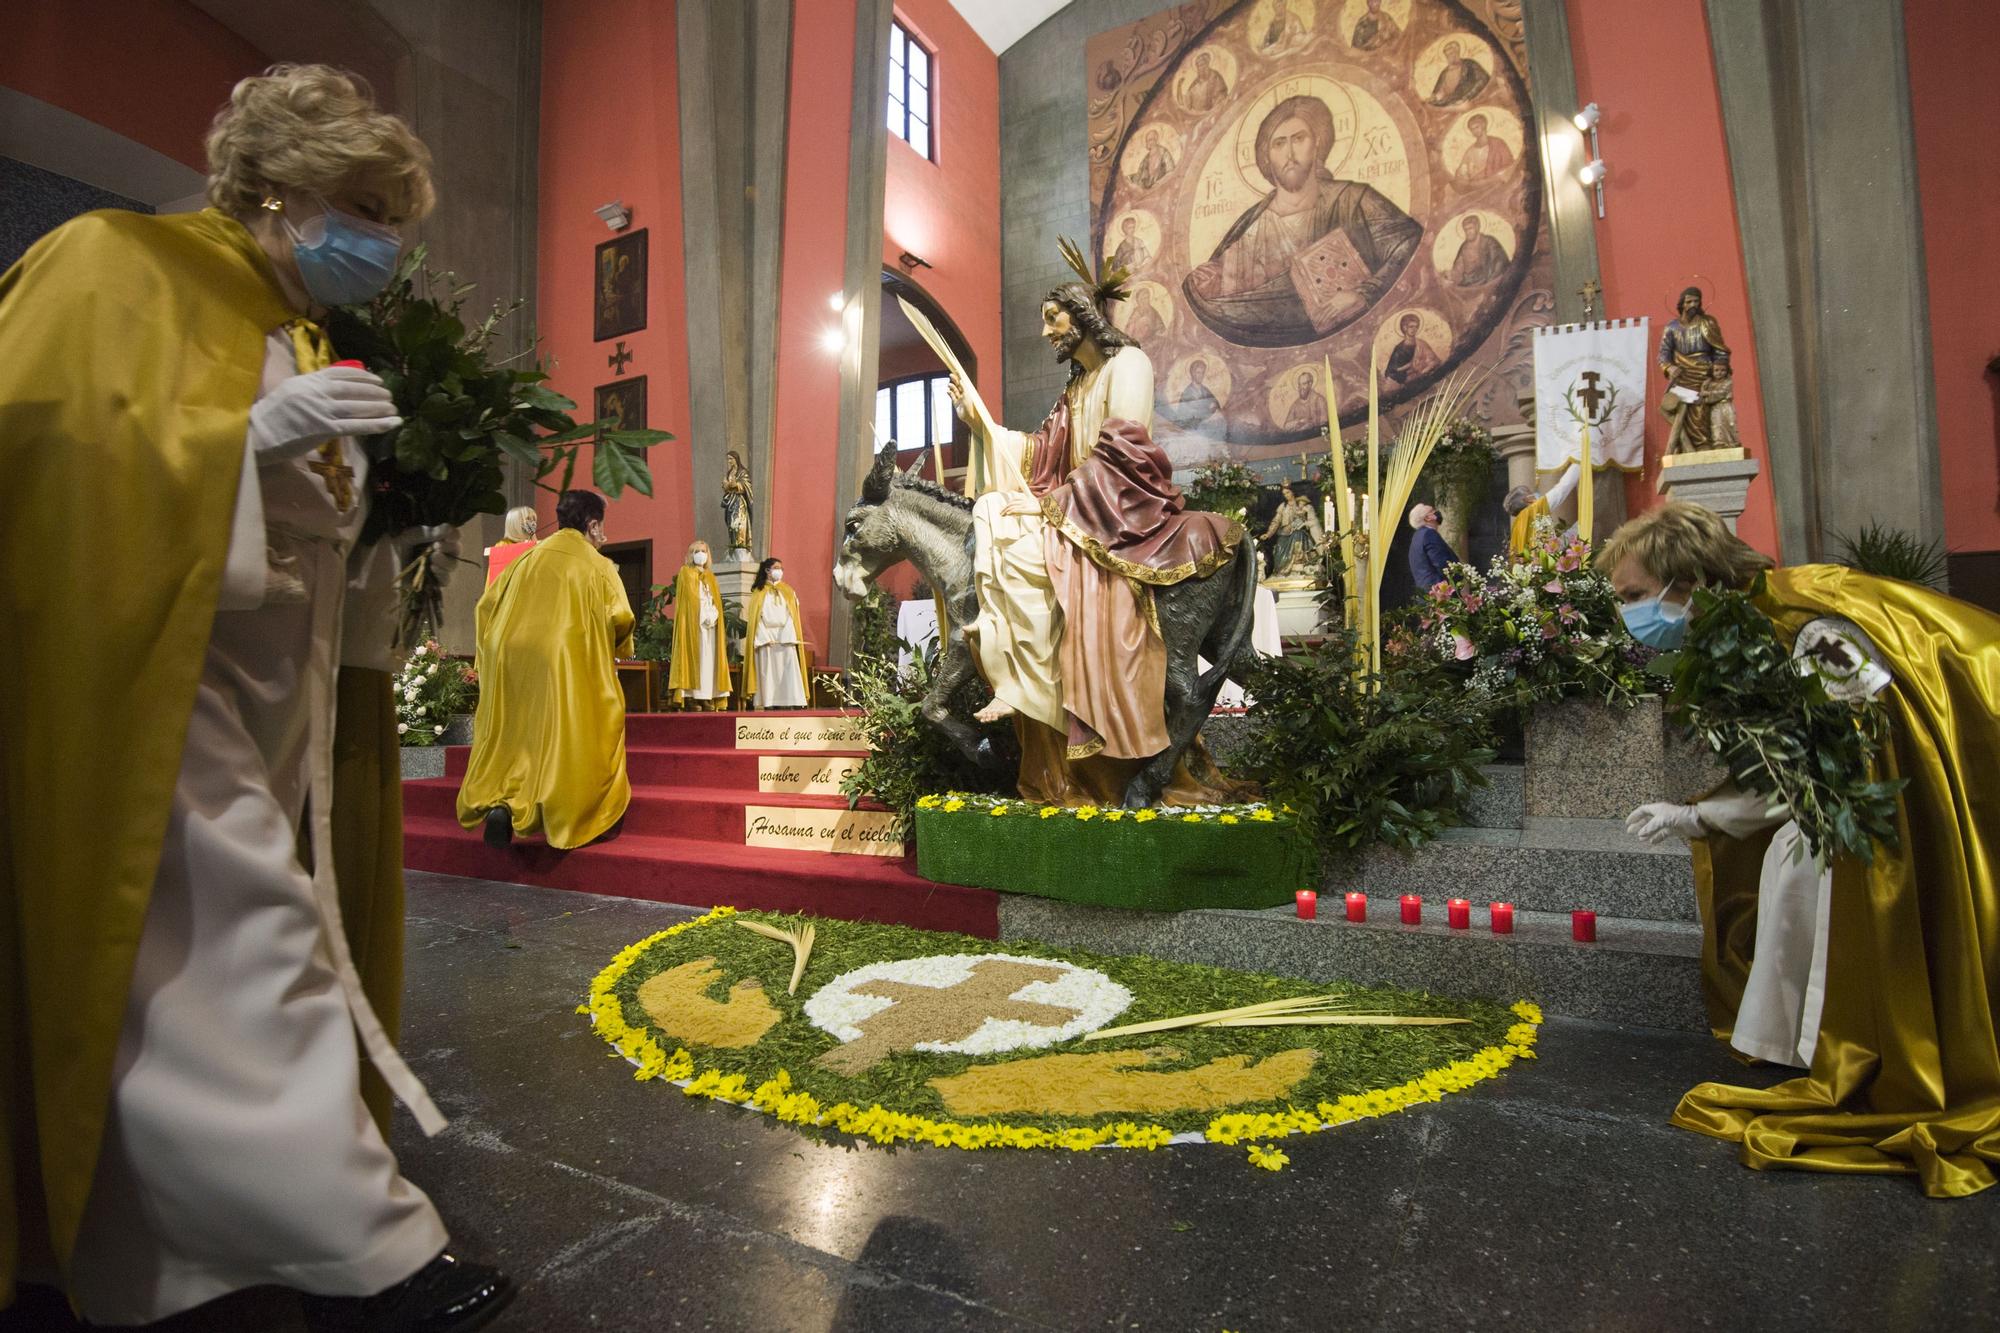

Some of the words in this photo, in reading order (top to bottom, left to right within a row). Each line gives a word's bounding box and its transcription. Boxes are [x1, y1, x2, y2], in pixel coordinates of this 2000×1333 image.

[737, 725, 774, 740] Bendito
[779, 727, 791, 740] el
[793, 731, 812, 745] que
[817, 729, 845, 741] viene
[849, 731, 861, 741] en
[760, 766, 800, 782] nombre
[811, 768, 832, 783] del
[747, 816, 814, 838] ¡Hosanna
[820, 828, 835, 839] en
[841, 823, 854, 840] el
